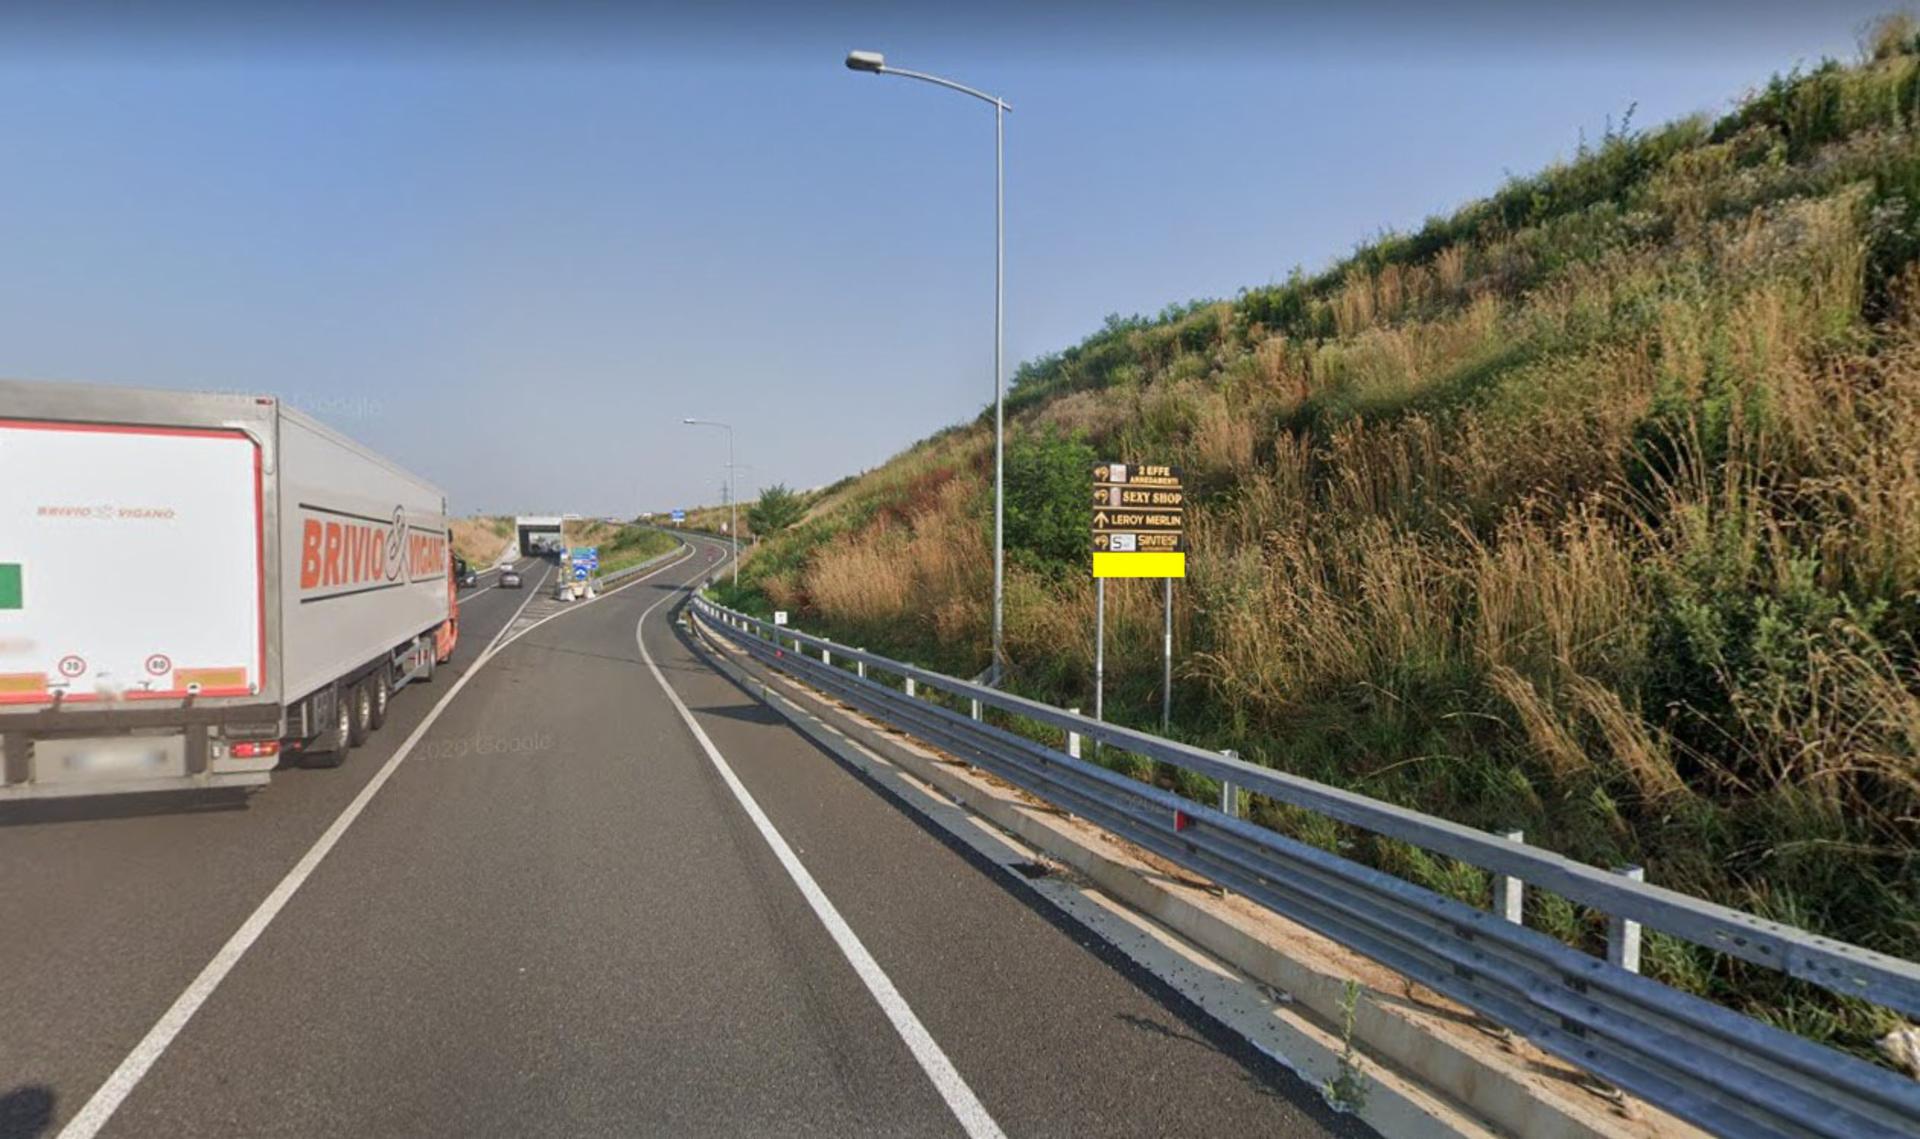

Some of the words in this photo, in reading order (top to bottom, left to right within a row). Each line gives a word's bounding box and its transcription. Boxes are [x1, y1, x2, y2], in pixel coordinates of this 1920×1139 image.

[1138, 466, 1145, 476] 2
[1146, 466, 1171, 477] EFFE
[1122, 491, 1151, 503] SEXY
[1152, 492, 1182, 505] SHOP
[37, 505, 91, 517] BRIVIO
[1111, 514, 1145, 525] LEROY
[1146, 515, 1181, 526] MERLIN
[1112, 536, 1122, 549] S
[1138, 535, 1178, 546] SINTESI
[301, 518, 385, 590] BRIVIO
